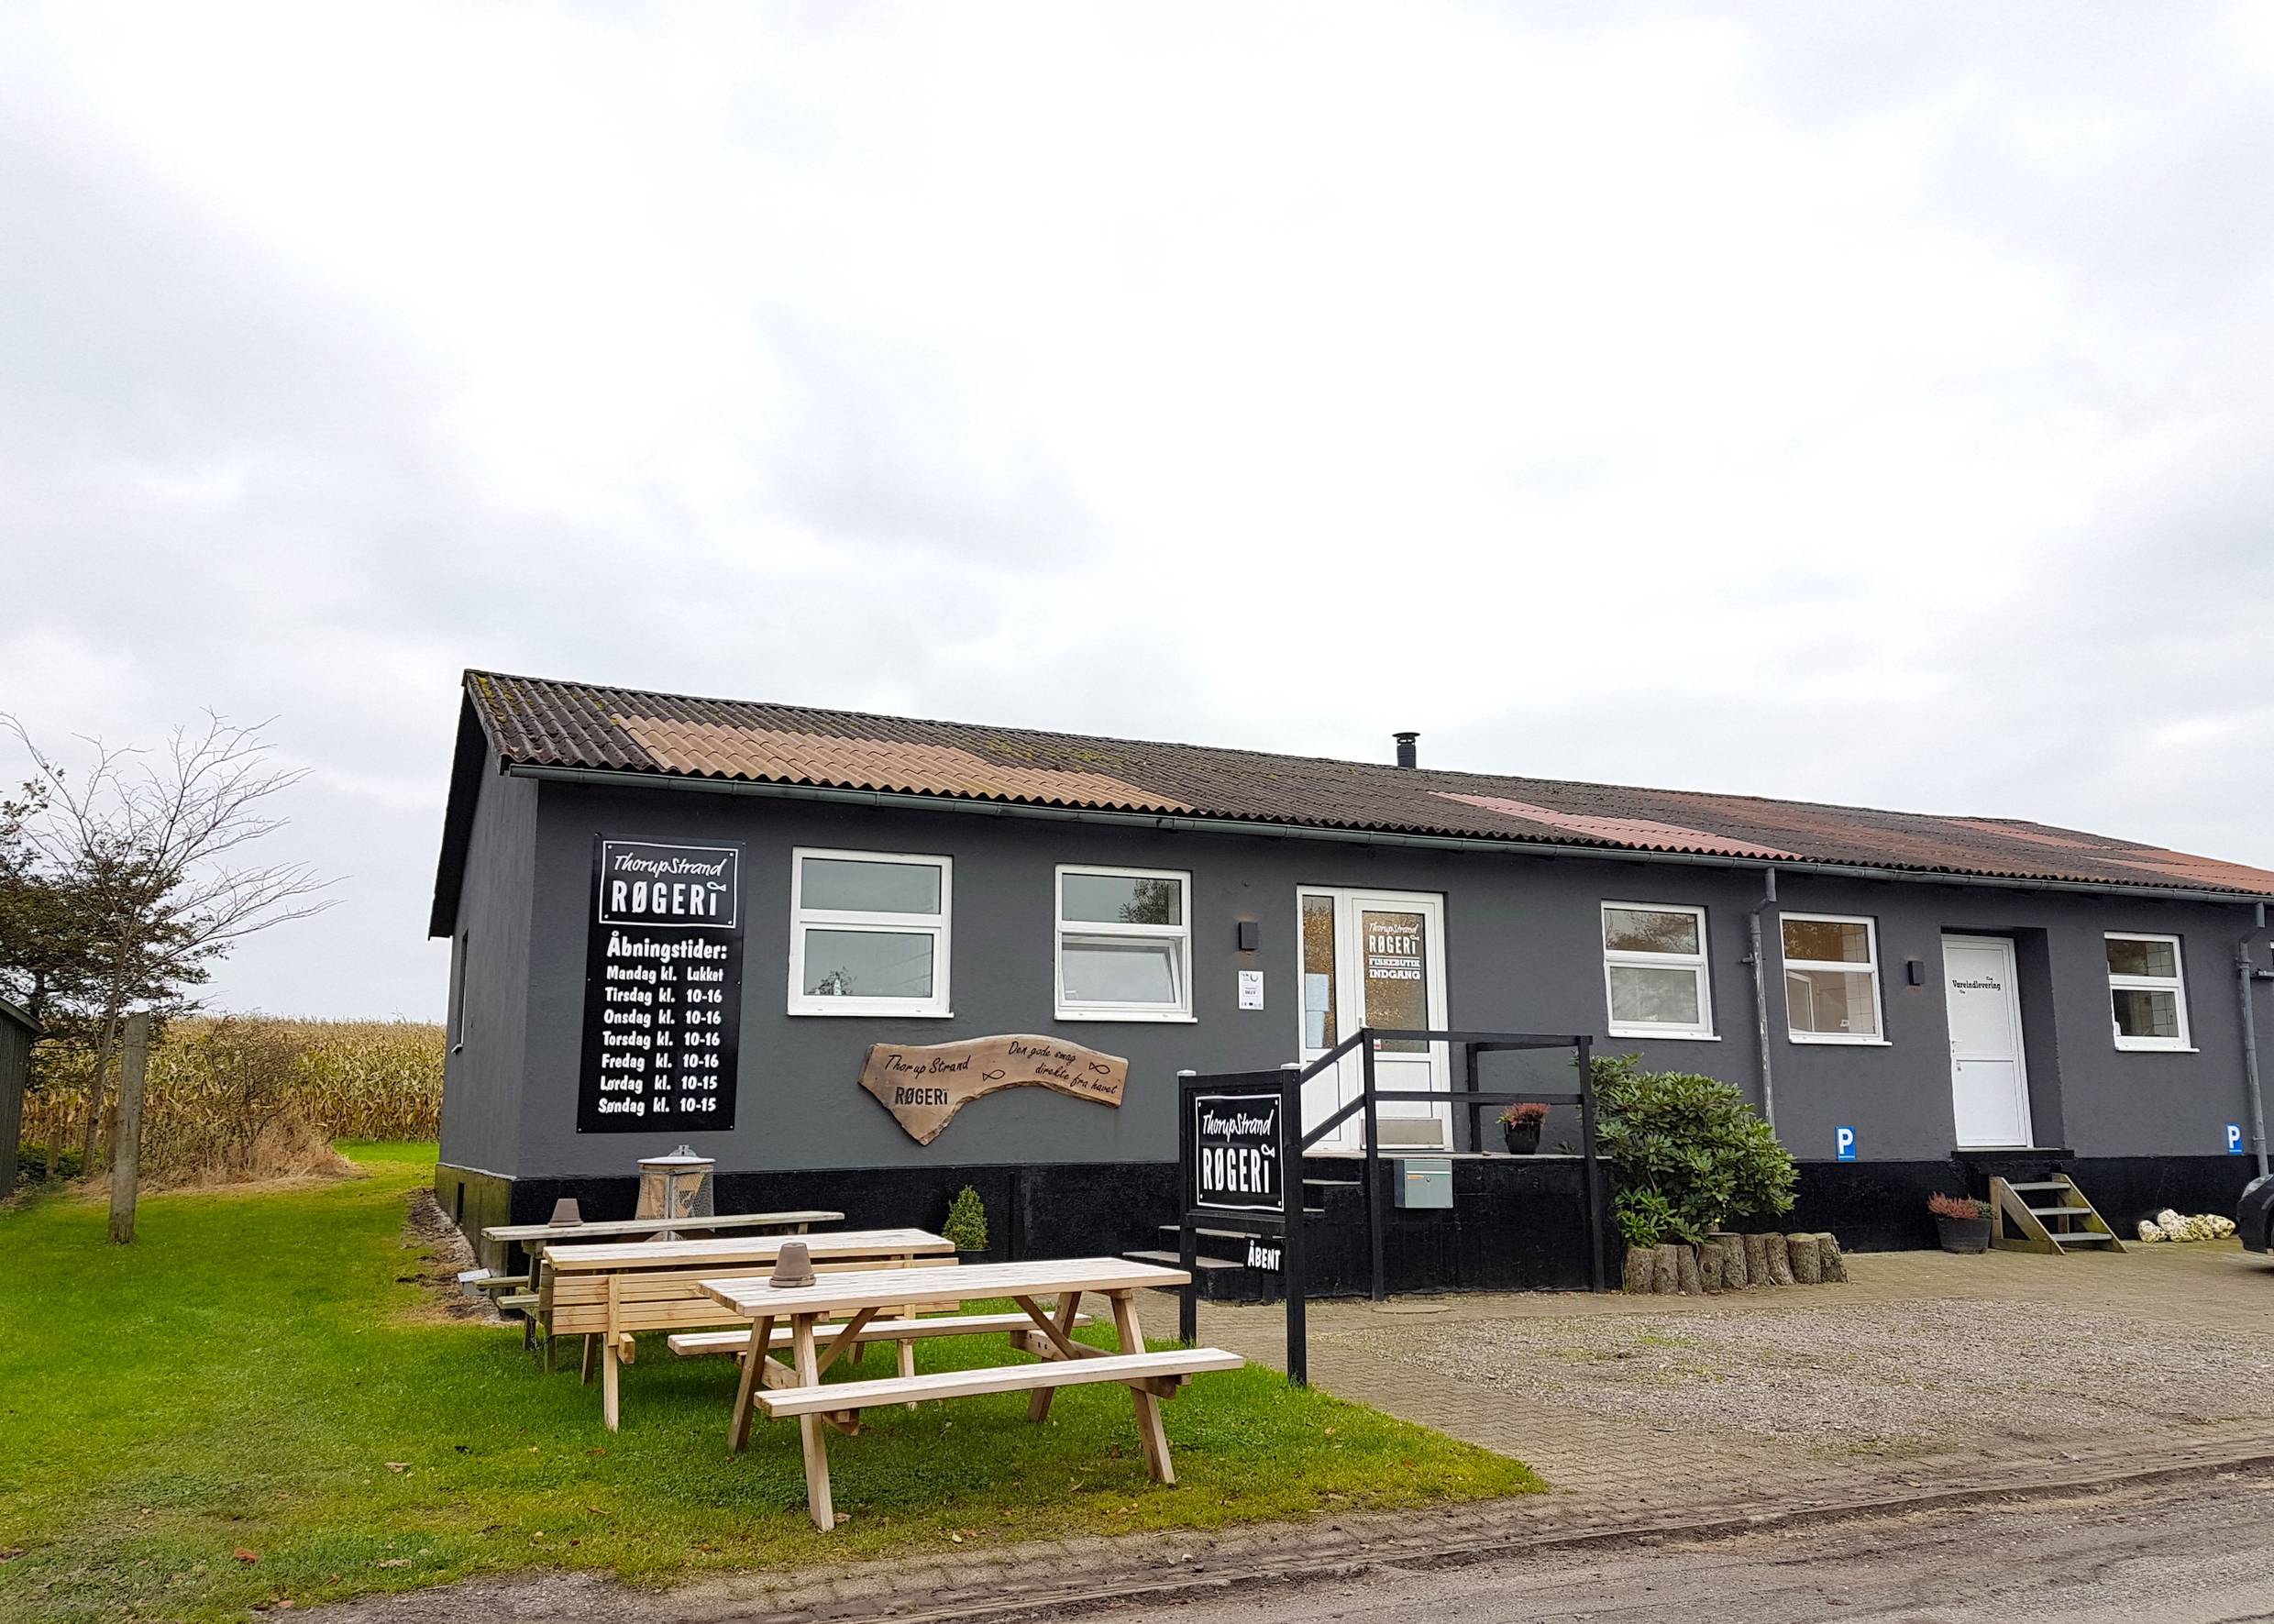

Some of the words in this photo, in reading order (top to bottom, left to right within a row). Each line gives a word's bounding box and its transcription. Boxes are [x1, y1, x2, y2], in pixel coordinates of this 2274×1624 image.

[606, 930, 727, 964] Åbningstider:
[606, 966, 657, 984] Mandag
[660, 966, 677, 981] kl.
[687, 967, 723, 982] Lukket
[1369, 969, 1420, 980] INDGANG
[1952, 979, 2001, 990] Vareindlevering
[605, 987, 652, 1005] Tirsdag
[658, 988, 675, 1003] kl.
[686, 989, 723, 1003] 10-16
[603, 1009, 651, 1027] Onsdag
[658, 1009, 675, 1024] kl.
[686, 1011, 721, 1025] 10-16
[602, 1031, 651, 1049] Torsdag
[657, 1032, 673, 1046] kl.
[684, 1032, 720, 1046] 10-16
[602, 1053, 645, 1072] Fredag
[656, 1054, 672, 1068] kl.
[683, 1054, 719, 1068] 10-16
[1009, 1041, 1027, 1055] Den
[1028, 1045, 1051, 1059] gode
[1054, 1051, 1076, 1066] smag
[884, 1055, 925, 1080] Thorup
[929, 1055, 971, 1074] Strand
[601, 1076, 643, 1094] Lørdag
[655, 1076, 671, 1090] kl.
[681, 1076, 718, 1090] 10-15
[1035, 1062, 1069, 1079] direkte
[1070, 1073, 1087, 1087] fra
[1091, 1078, 1118, 1094] havet
[599, 1098, 645, 1117] Søndag
[653, 1098, 669, 1112] kl.
[679, 1098, 716, 1112] 10-15
[1838, 1128, 1854, 1154] P
[2227, 1125, 2241, 1149] P
[1247, 1240, 1281, 1271] ÅBENT
